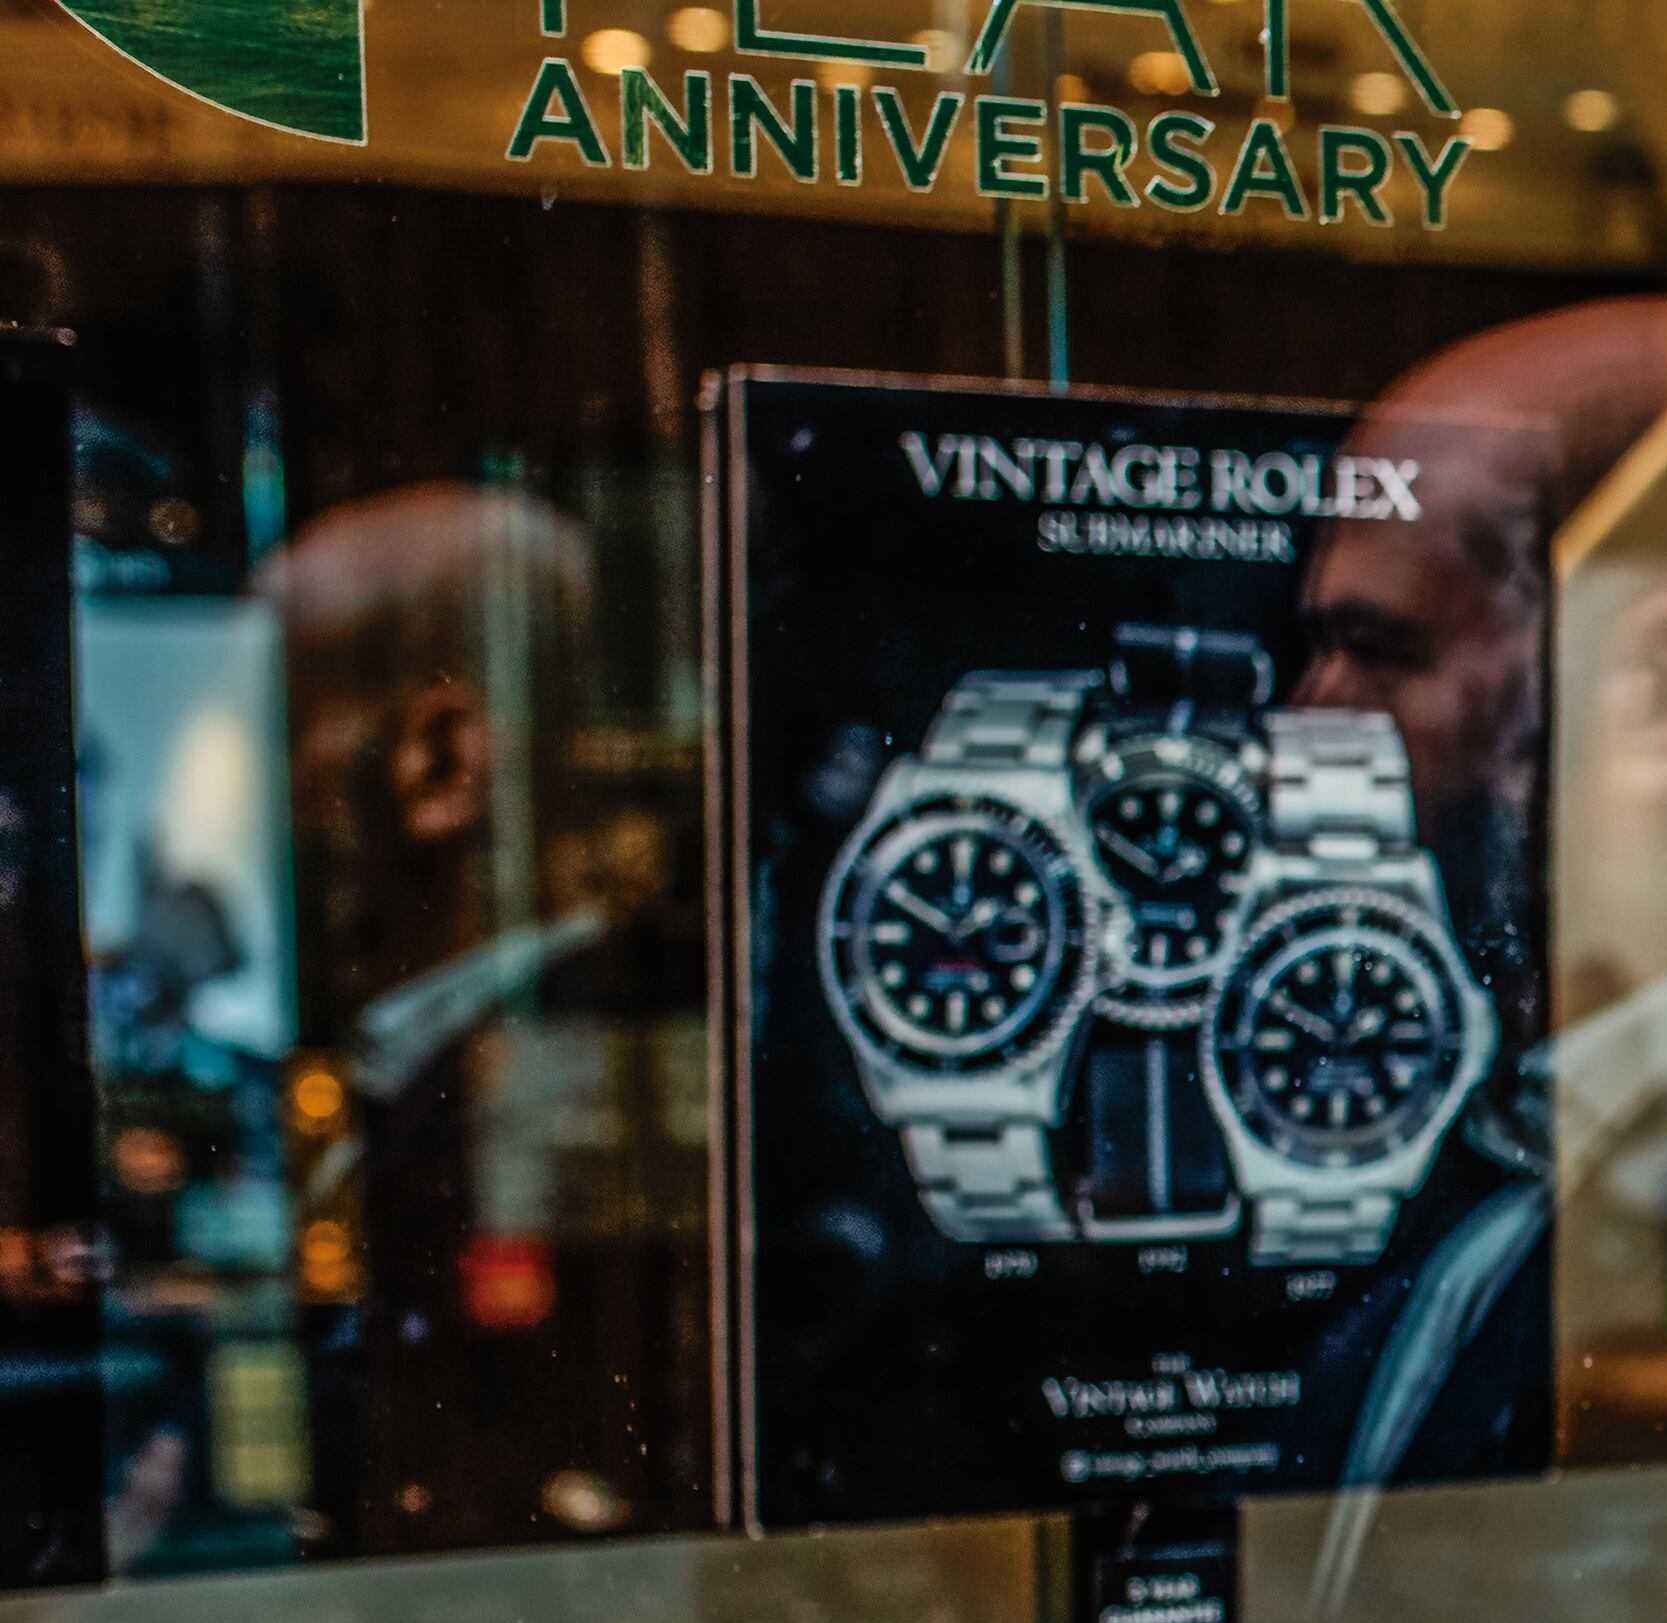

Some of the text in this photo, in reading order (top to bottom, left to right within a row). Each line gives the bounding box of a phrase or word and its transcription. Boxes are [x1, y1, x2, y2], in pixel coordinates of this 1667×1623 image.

[506, 57, 1476, 231] ANNIVERSARY
[898, 430, 1423, 522] VINTAGE ROLEX
